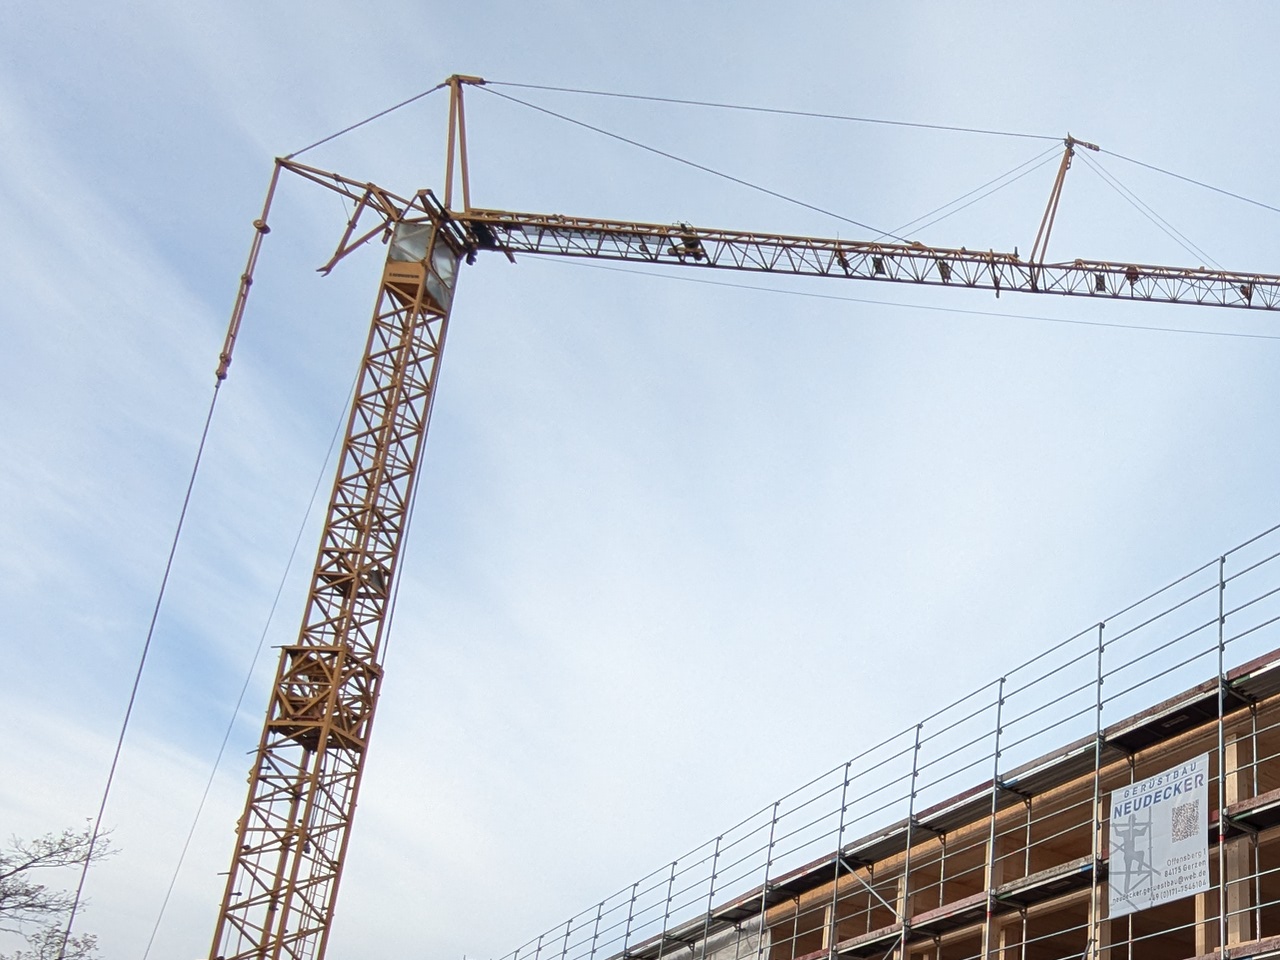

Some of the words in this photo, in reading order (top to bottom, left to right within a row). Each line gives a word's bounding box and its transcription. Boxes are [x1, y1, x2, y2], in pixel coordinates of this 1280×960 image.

[1123, 762, 1197, 798] GERÜSTBAU
[1113, 773, 1204, 819] NEUDECKER
[1164, 866, 1182, 878] 84175
[1183, 860, 1206, 872] Gerzen
[1166, 850, 1202, 867] Offensberg
